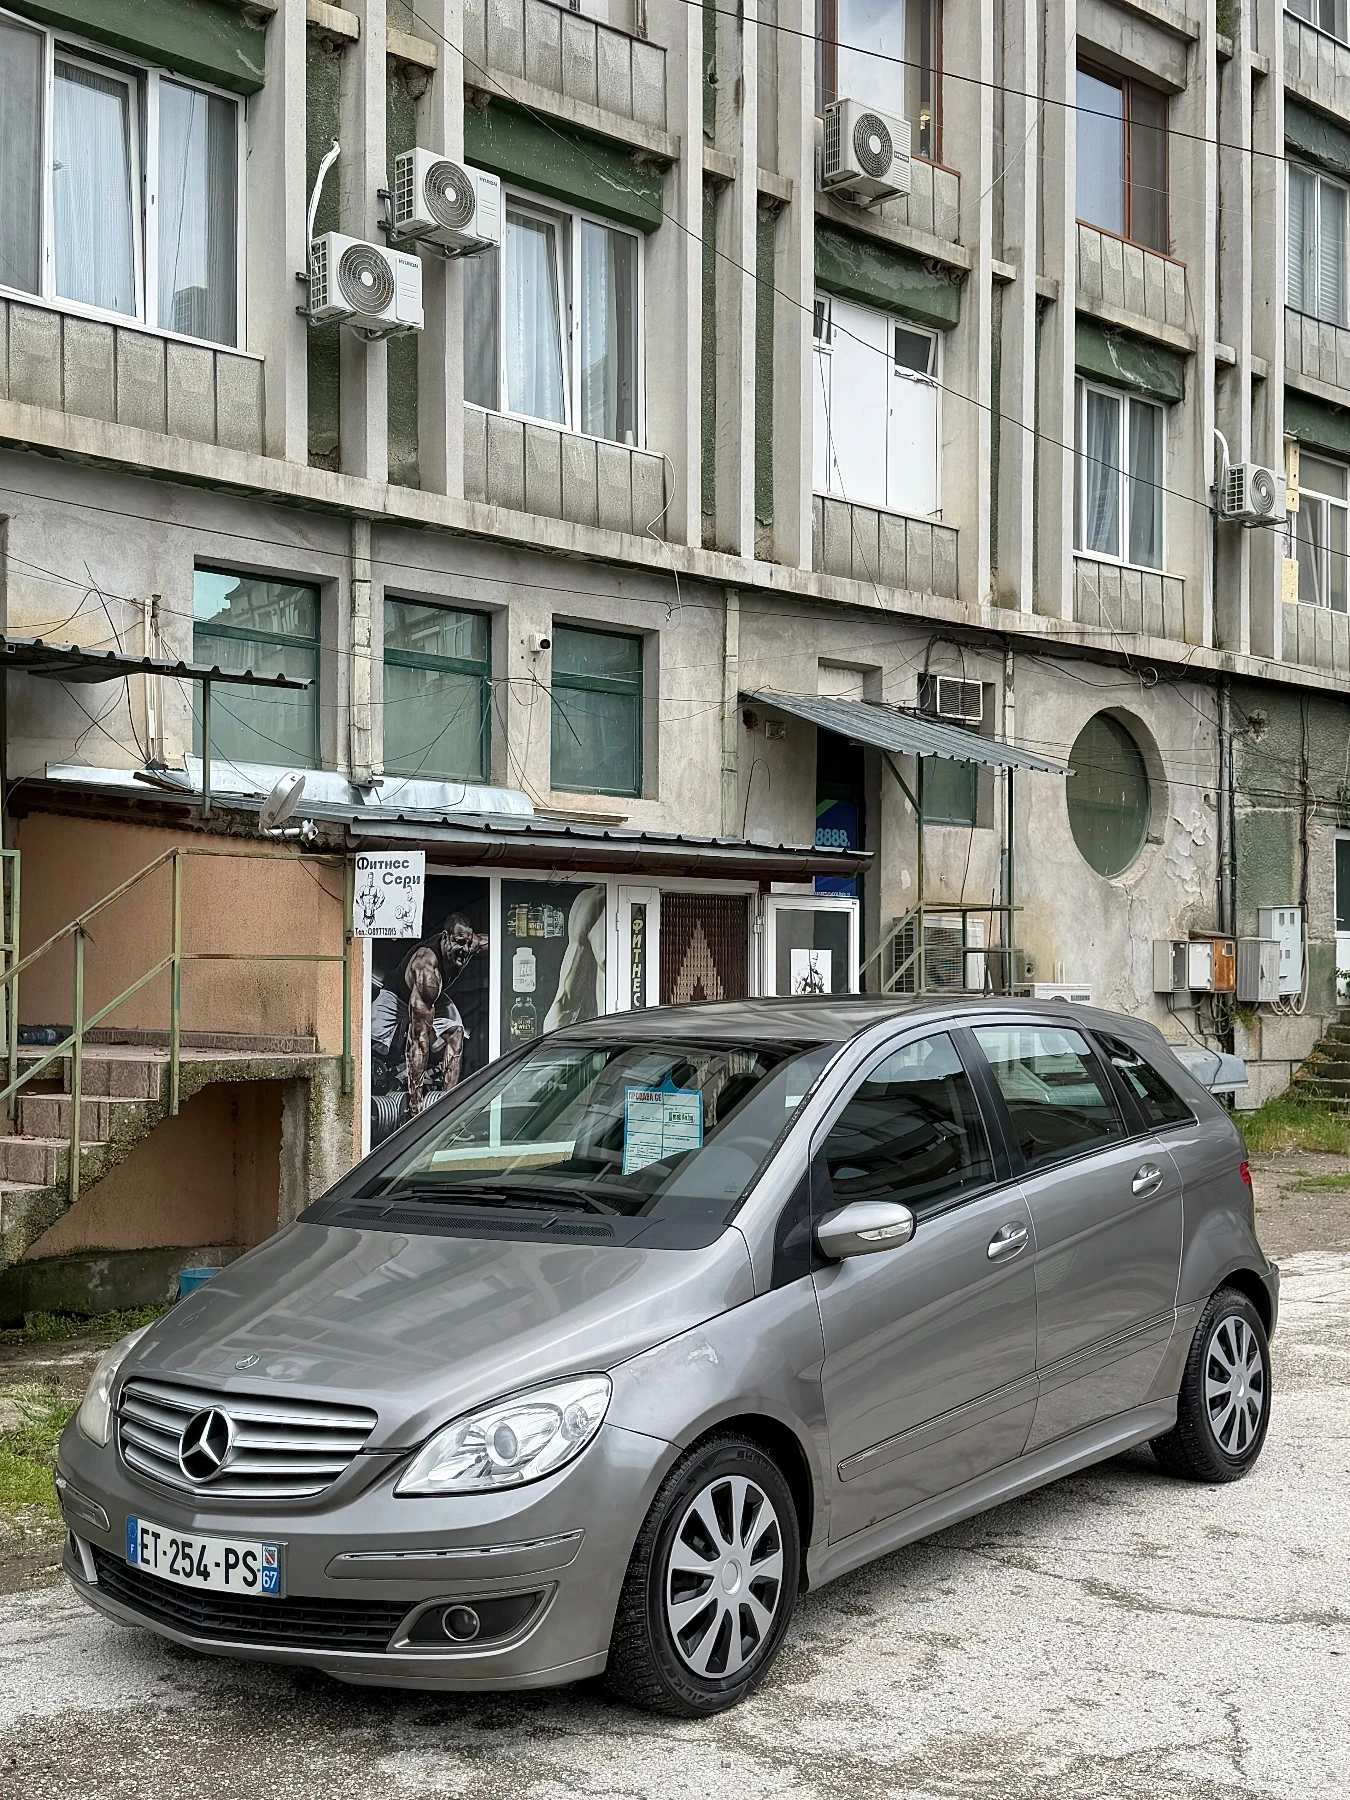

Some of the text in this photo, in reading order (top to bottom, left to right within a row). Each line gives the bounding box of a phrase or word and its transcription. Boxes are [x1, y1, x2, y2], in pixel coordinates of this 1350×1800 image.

[479, 177, 497, 187] HYUNDAI
[398, 258, 418, 269] HYUNDAI
[632, 919, 644, 1007] ФИТНЕС
[628, 1091, 662, 1102] ПРОДАВА СЕ
[130, 1543, 135, 1554] F
[140, 1527, 258, 1588] ET-254-PS
[262, 1570, 278, 1588] 67
